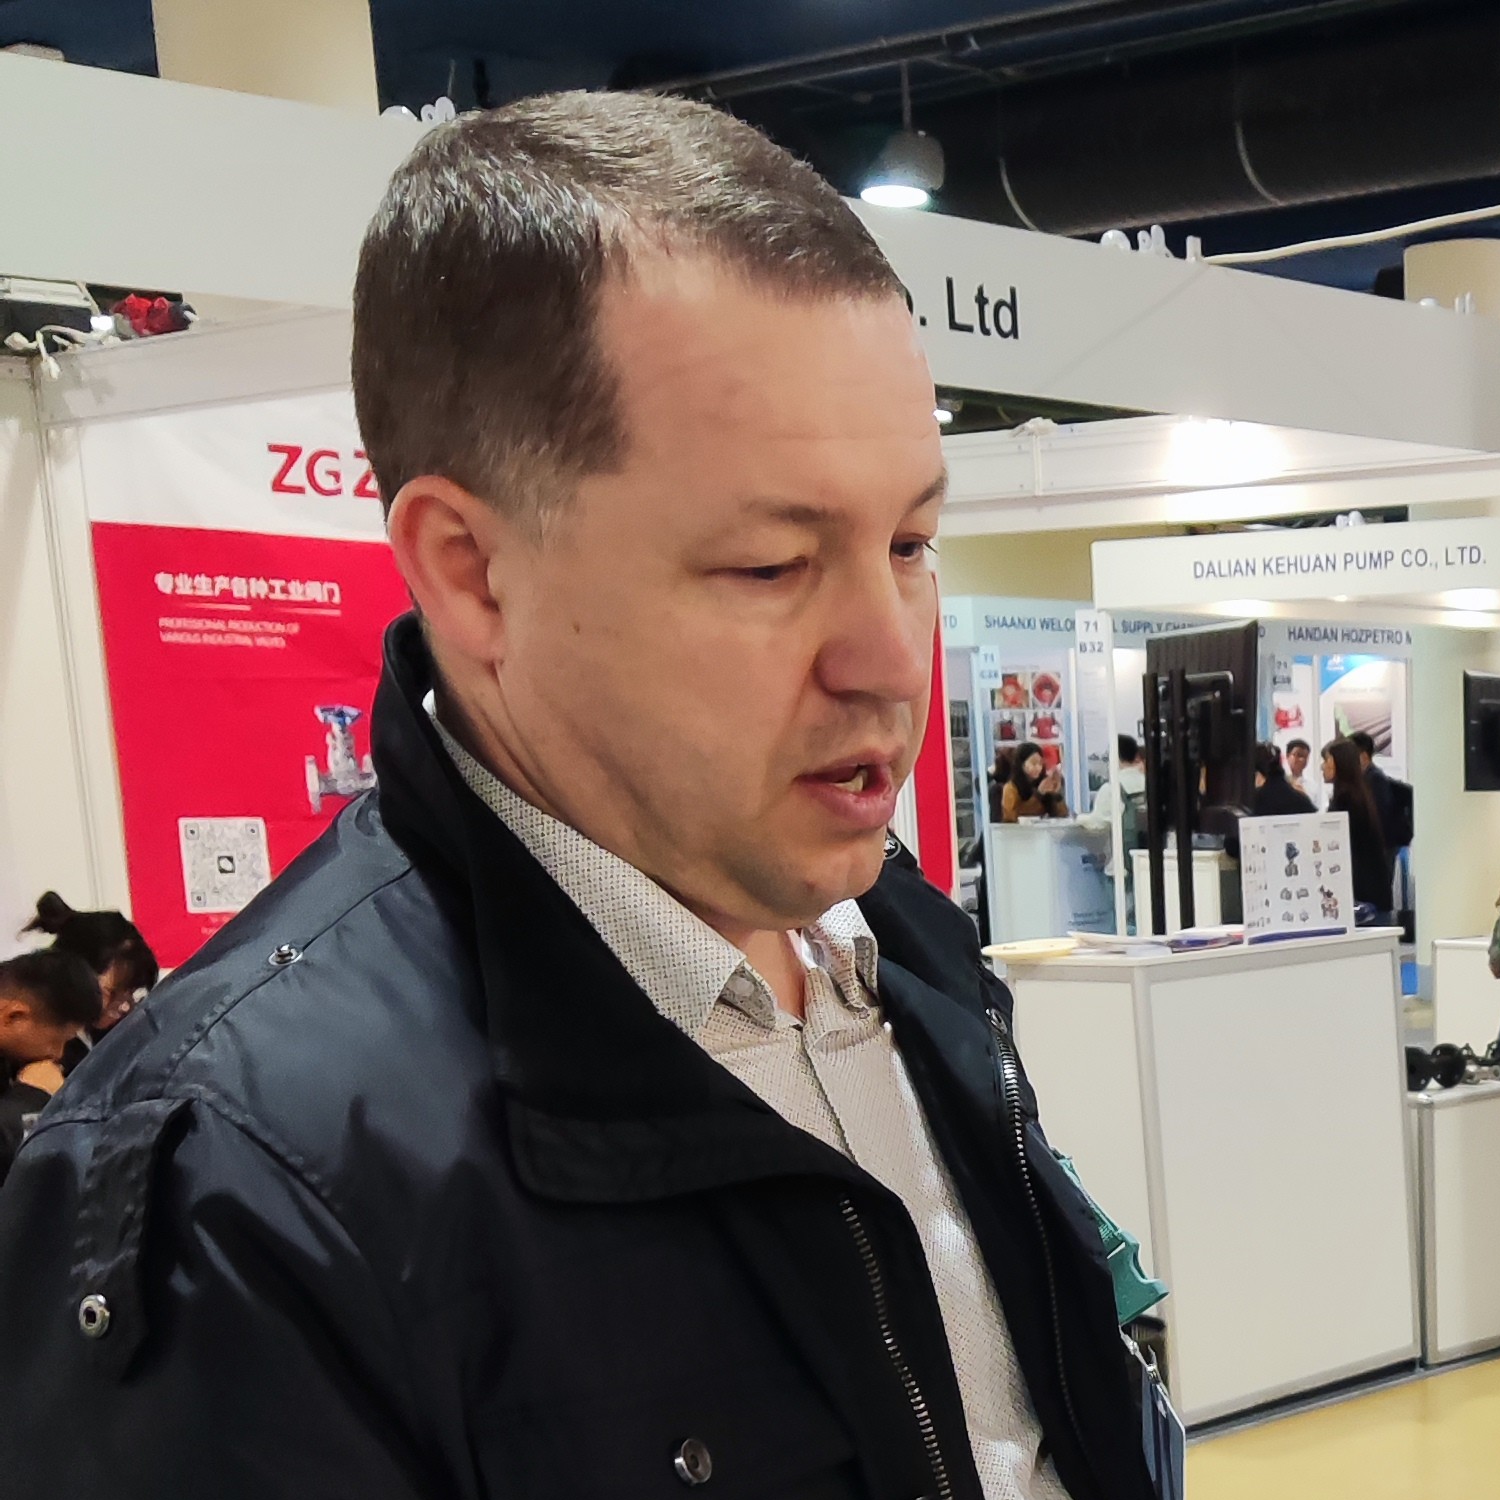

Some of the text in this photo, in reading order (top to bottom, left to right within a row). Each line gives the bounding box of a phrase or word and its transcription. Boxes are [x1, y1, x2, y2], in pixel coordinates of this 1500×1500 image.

[946, 276, 1020, 340] Ltd
[1193, 545, 1487, 579] DALIAN KEHUAN PUMP CO., LTD.
[1083, 620, 1099, 632] 71
[1287, 626, 1338, 643] HANDAN
[1341, 627, 1403, 645] HOZPETRO
[1079, 641, 1104, 653] B32
